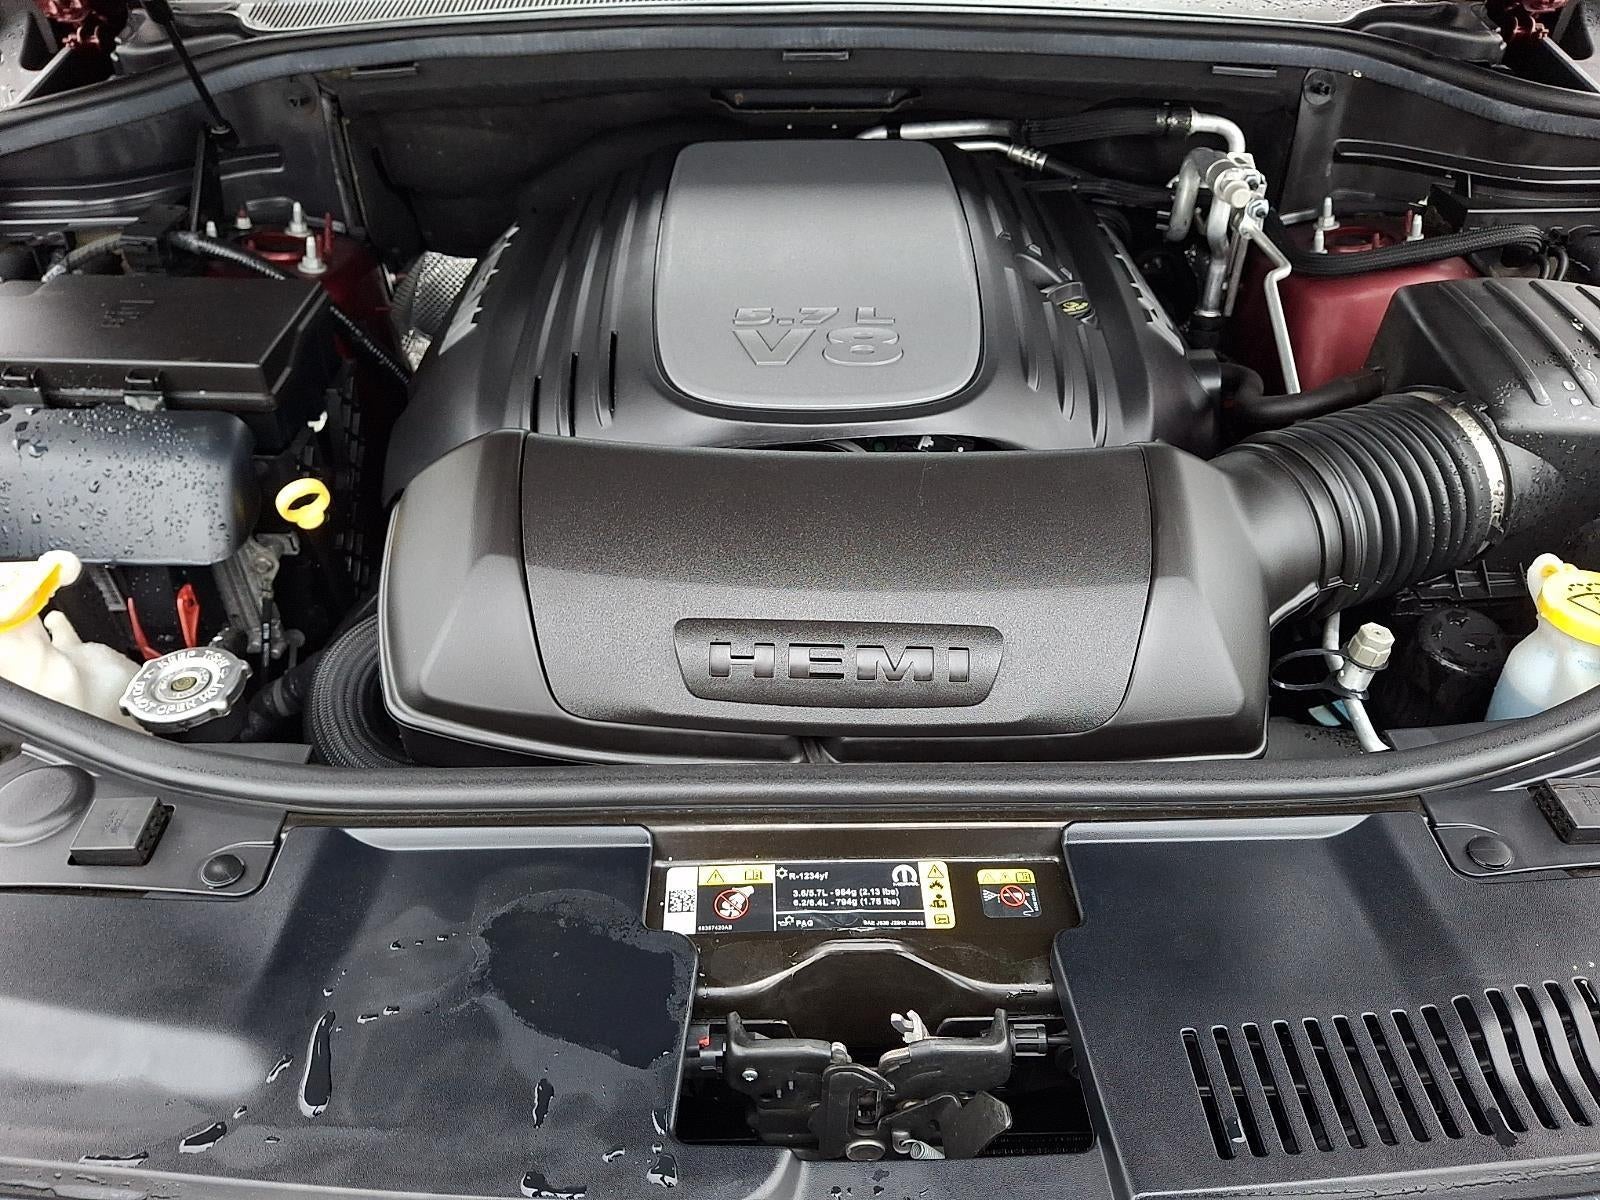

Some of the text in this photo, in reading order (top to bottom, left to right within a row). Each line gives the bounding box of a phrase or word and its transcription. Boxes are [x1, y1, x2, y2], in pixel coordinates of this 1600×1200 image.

[733, 306, 896, 327] 5.7 L
[732, 326, 904, 367] V8
[708, 641, 970, 683] HEMI
[156, 699, 198, 716] OPEN
[788, 871, 829, 881] R-1234yf
[792, 888, 829, 898] 3.6/5.7L
[795, 919, 814, 928] PAG
